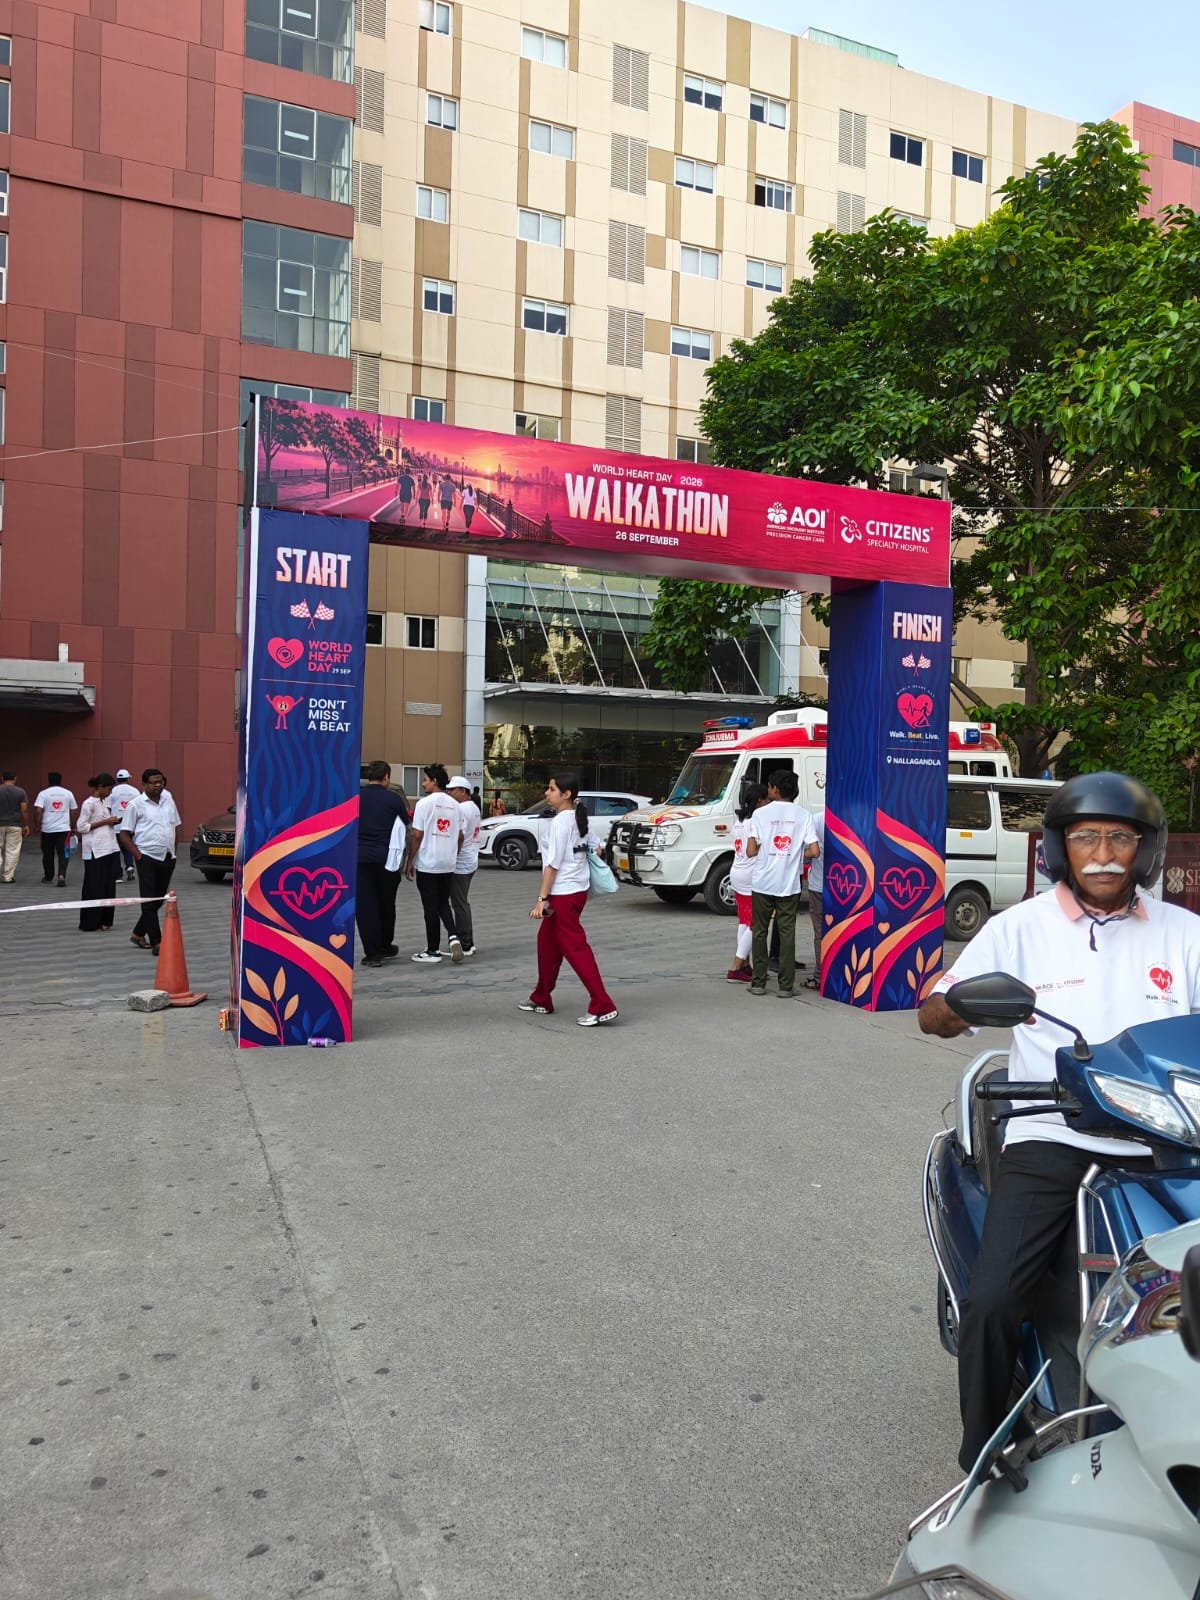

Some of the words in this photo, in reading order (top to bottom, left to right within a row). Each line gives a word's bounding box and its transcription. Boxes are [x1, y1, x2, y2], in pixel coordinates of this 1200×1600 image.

[592, 463, 625, 476] WORLD
[626, 468, 654, 480] HEART
[655, 473, 673, 483] DAY
[680, 475, 703, 487] 2026
[565, 473, 729, 537] WALKATHON
[789, 506, 826, 528] AOI
[616, 530, 627, 541] 26
[628, 532, 680, 546] SEPTEMBER
[866, 520, 930, 542] CITIZENS
[867, 538, 898, 550] SPECIALTY
[900, 544, 928, 554] HOSPITAL
[275, 546, 352, 588] START
[892, 611, 942, 643] FINISH
[308, 640, 352, 653] WORLD
[308, 651, 348, 663] HEART
[308, 662, 332, 672] DAY
[308, 698, 348, 710] DON'T
[308, 710, 340, 720] MISS
[308, 720, 316, 730] A
[320, 721, 351, 732] BEAT
[893, 758, 942, 766] NALLAGANDLA
